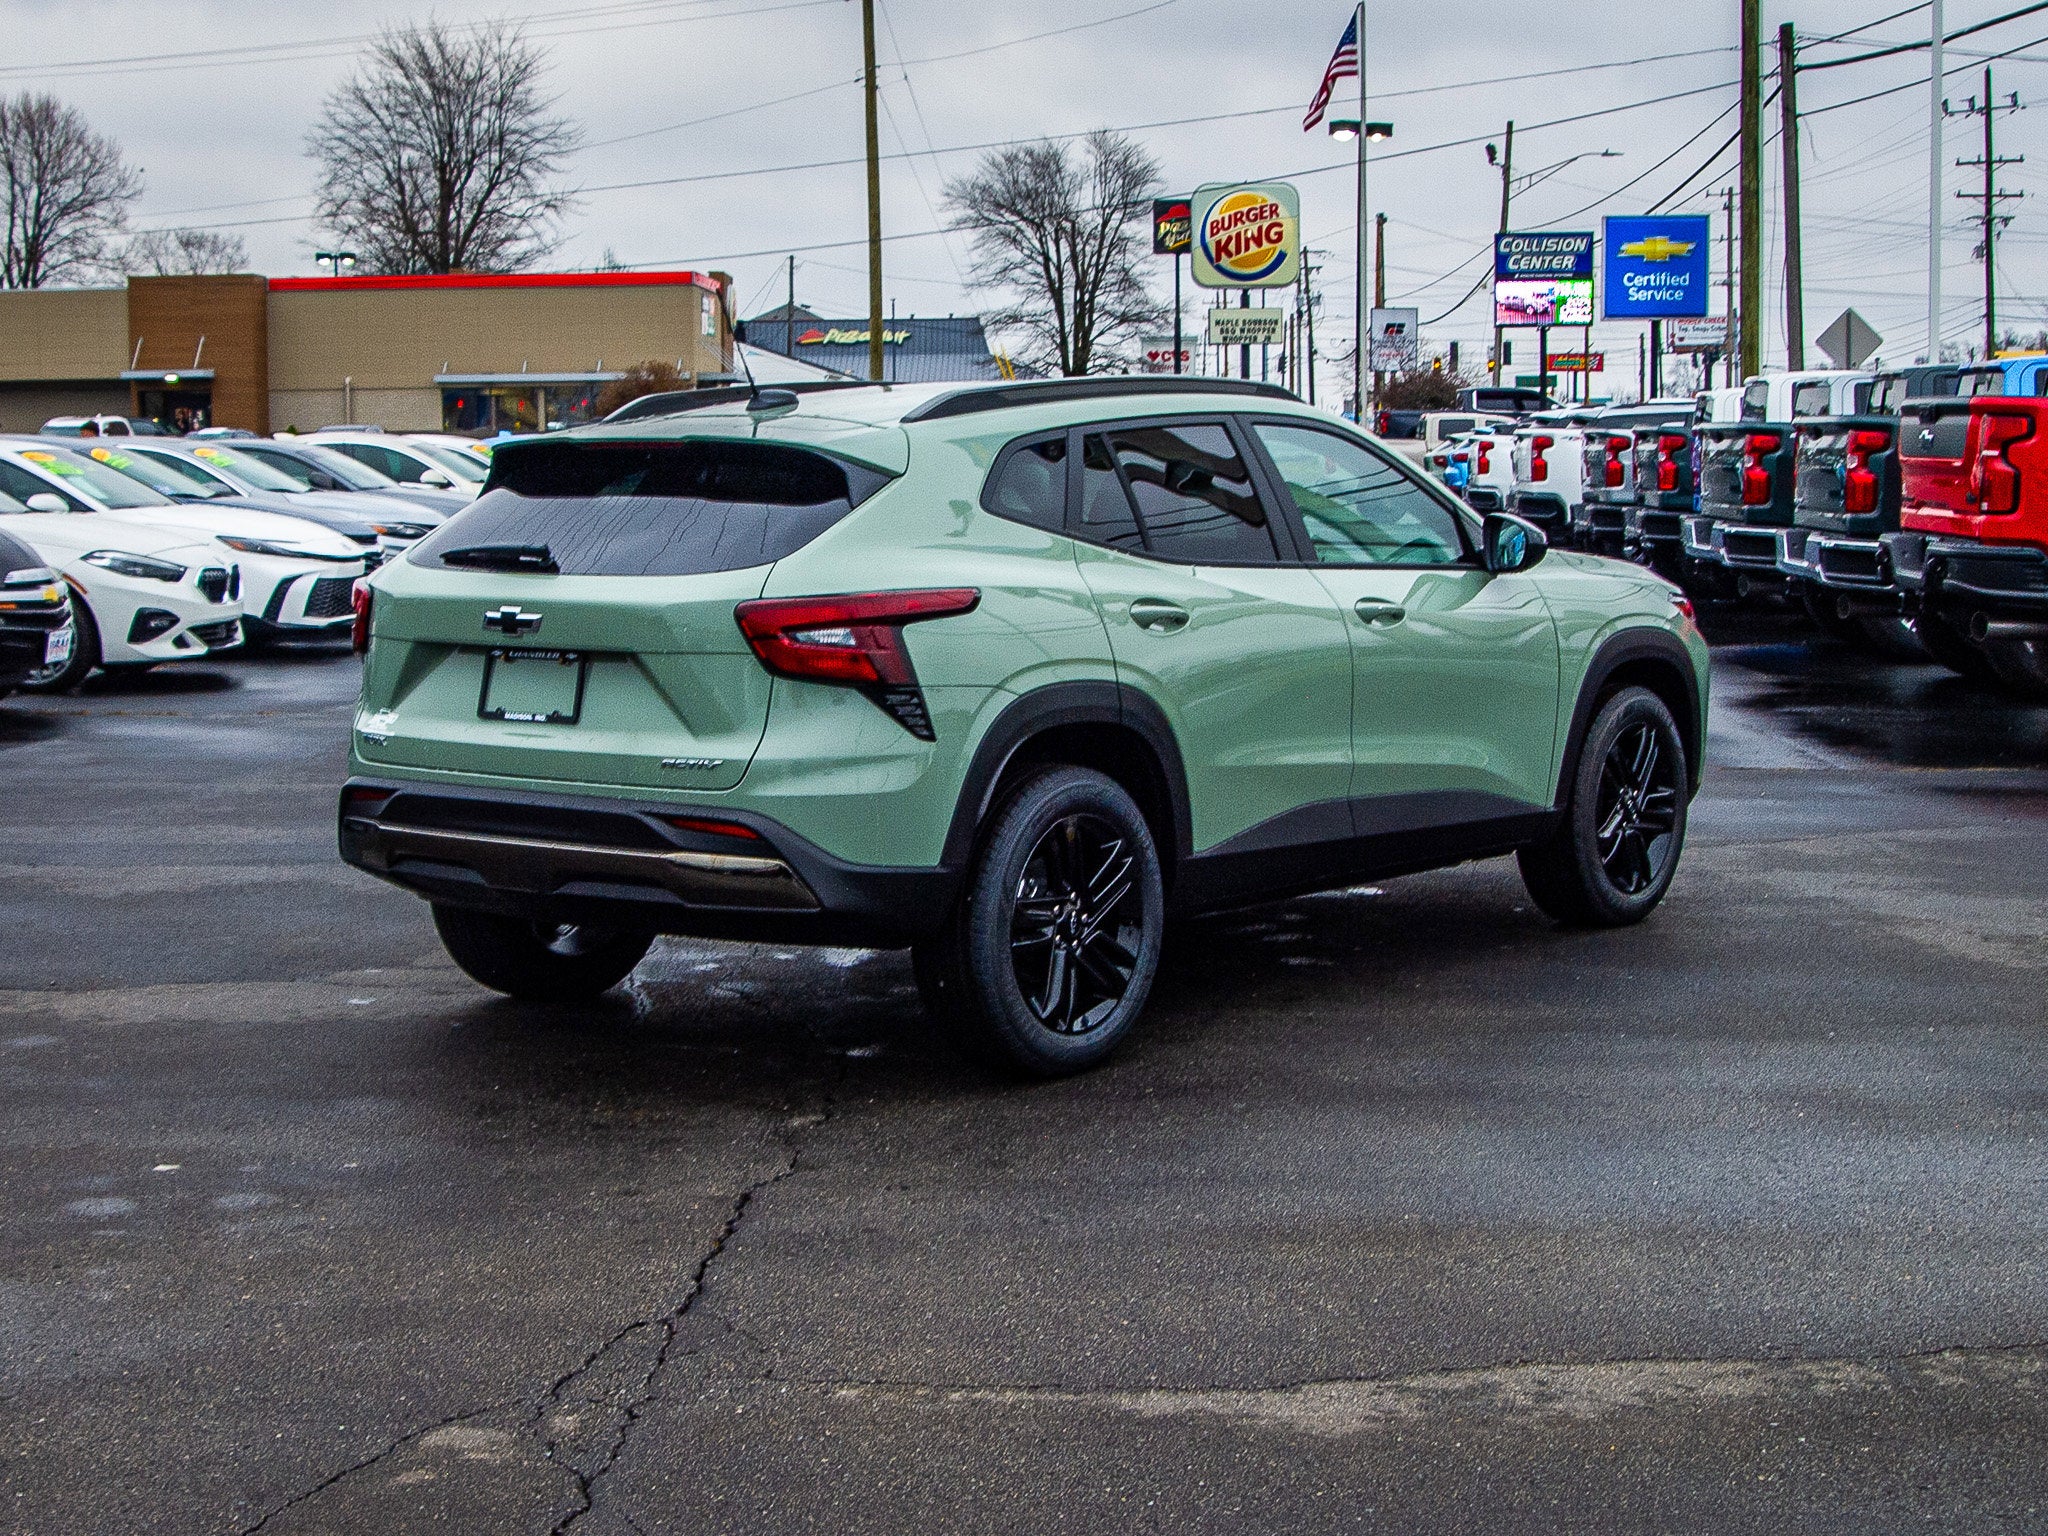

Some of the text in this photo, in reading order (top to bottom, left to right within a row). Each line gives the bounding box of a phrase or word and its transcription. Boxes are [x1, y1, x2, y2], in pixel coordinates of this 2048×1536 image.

[1209, 203, 1280, 239] BURGER
[1214, 221, 1284, 264] KING
[1499, 237, 1588, 253] COLLISION
[1507, 254, 1575, 270] CENTER
[1622, 271, 1690, 287] Certified
[1627, 286, 1684, 301] Service
